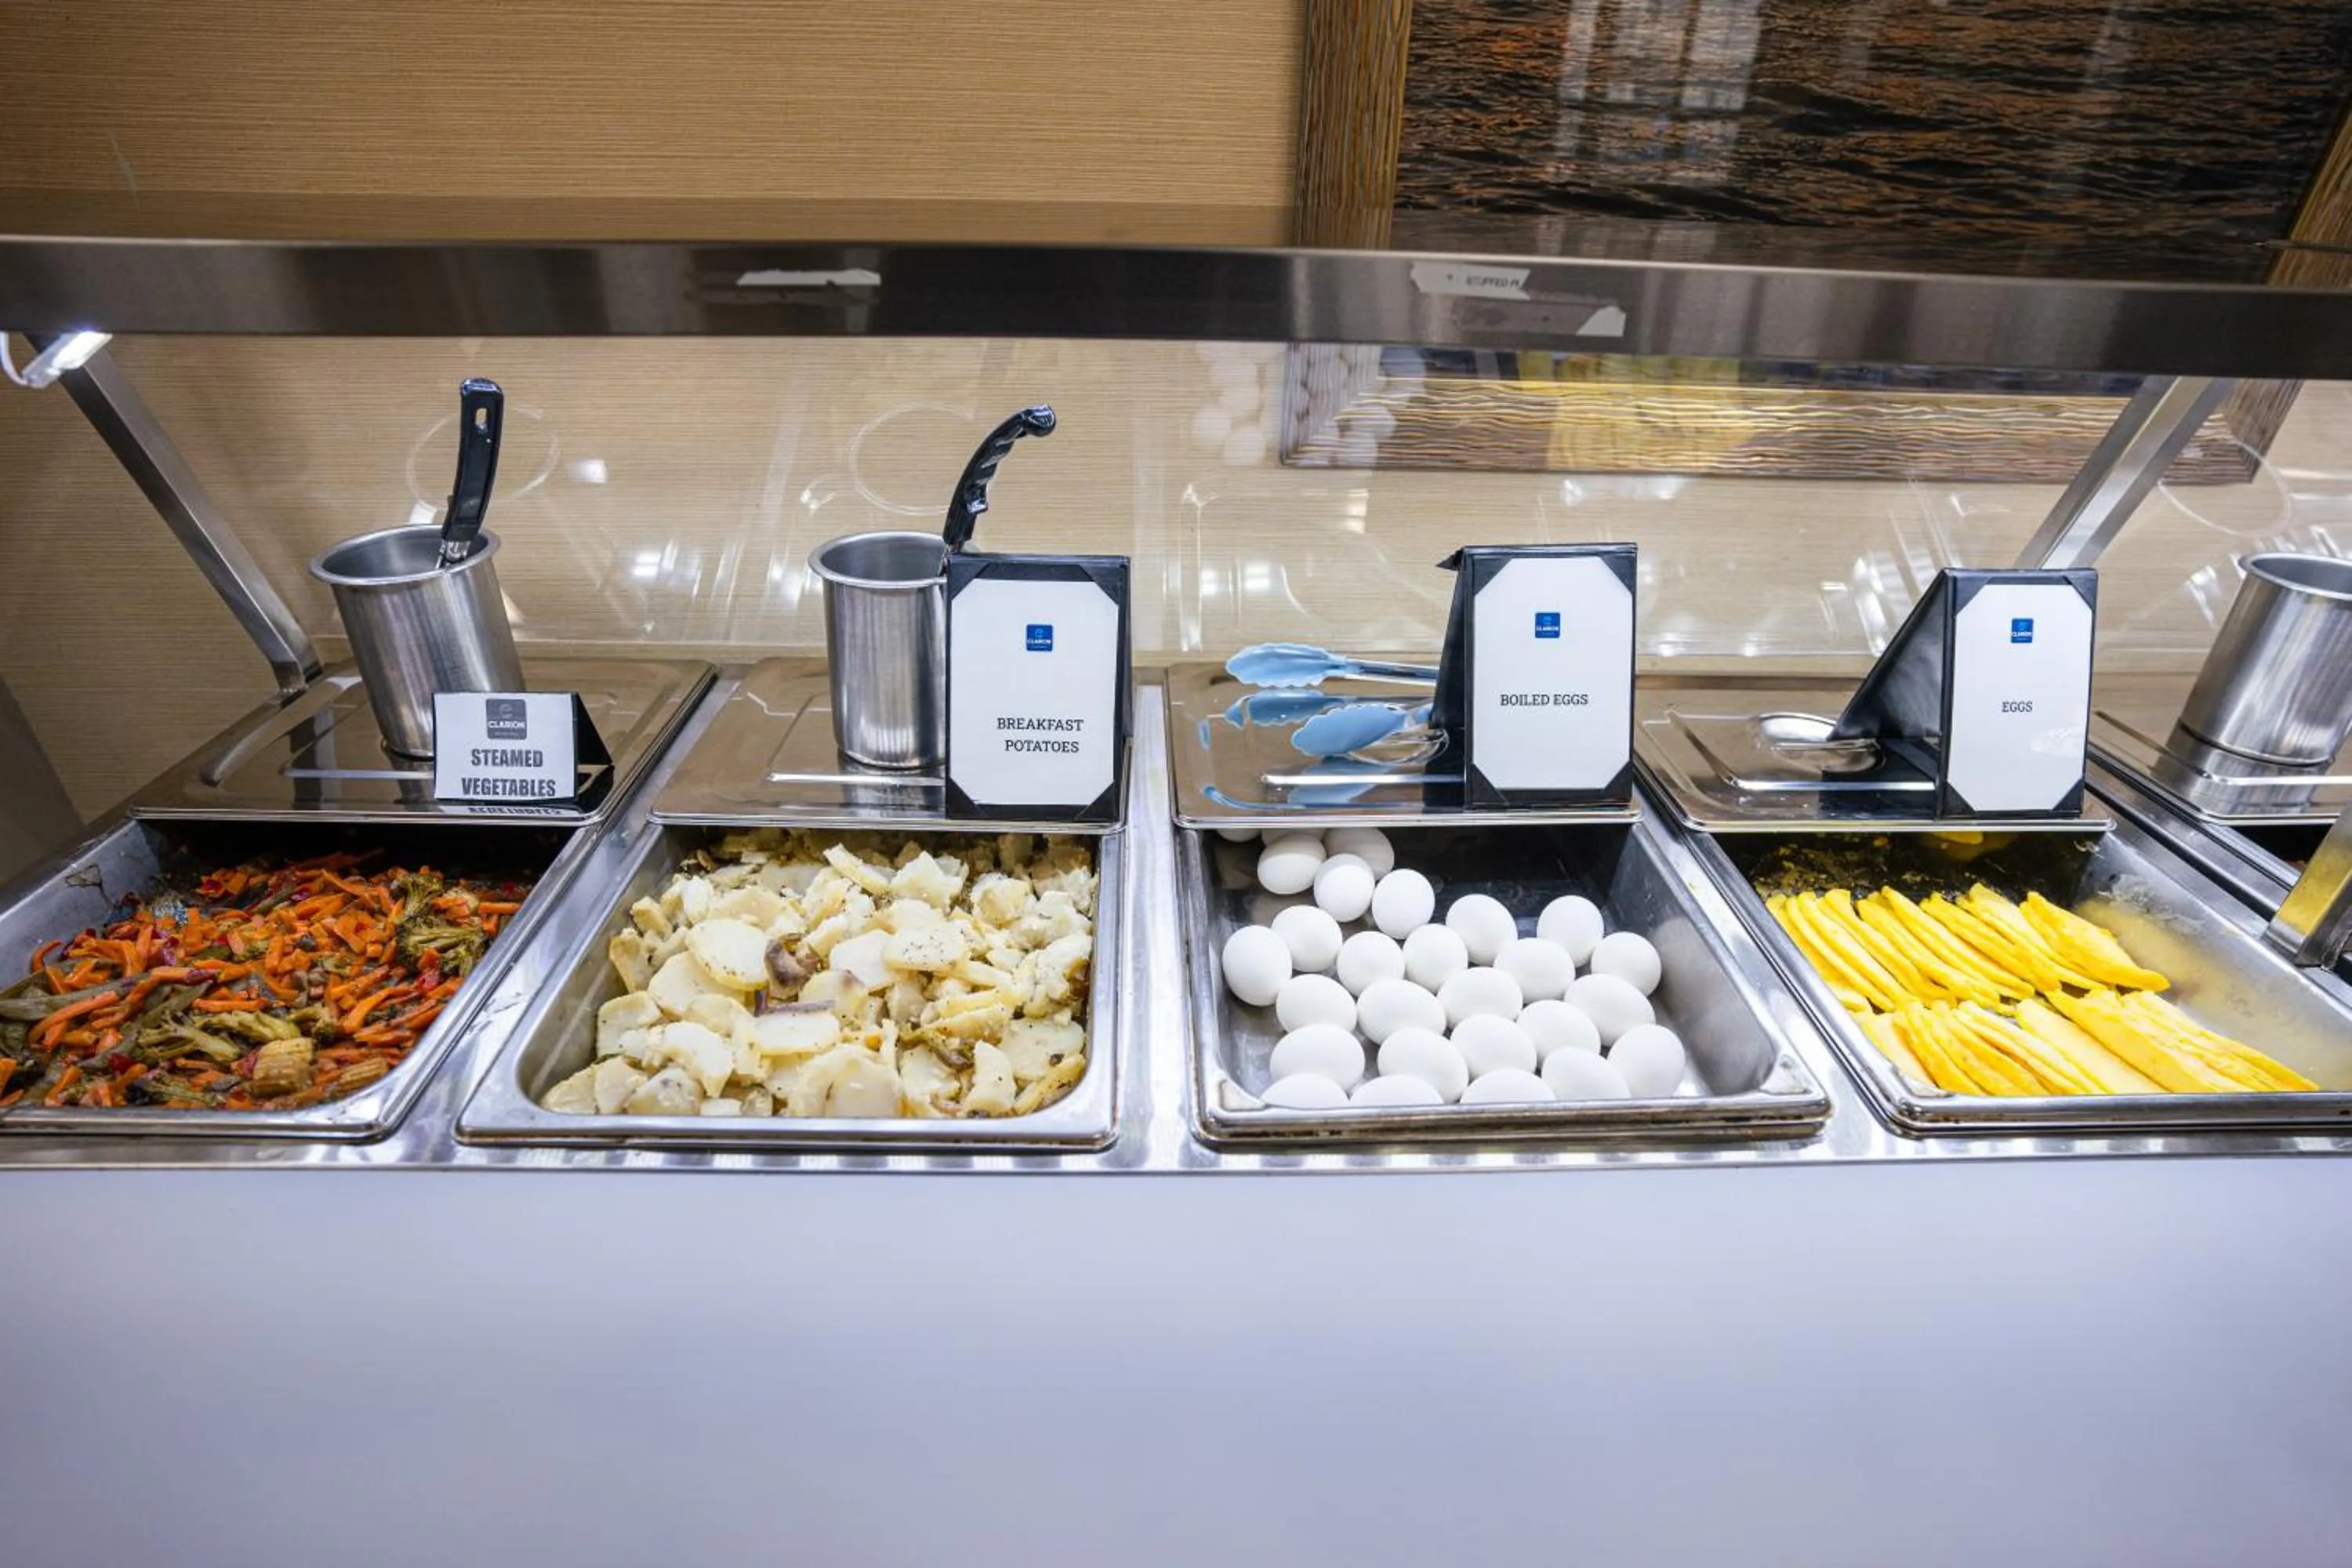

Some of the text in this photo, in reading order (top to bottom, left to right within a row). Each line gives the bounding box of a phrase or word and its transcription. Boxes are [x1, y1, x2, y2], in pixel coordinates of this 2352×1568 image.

[1500, 694, 1589, 706] BOILED EGGS
[2002, 701, 2033, 713] EGGS
[996, 717, 1084, 731] BREAKFAST
[1004, 739, 1080, 753] POTATOES
[470, 749, 543, 768] STEAMED
[461, 777, 557, 797] VEGETABLES
